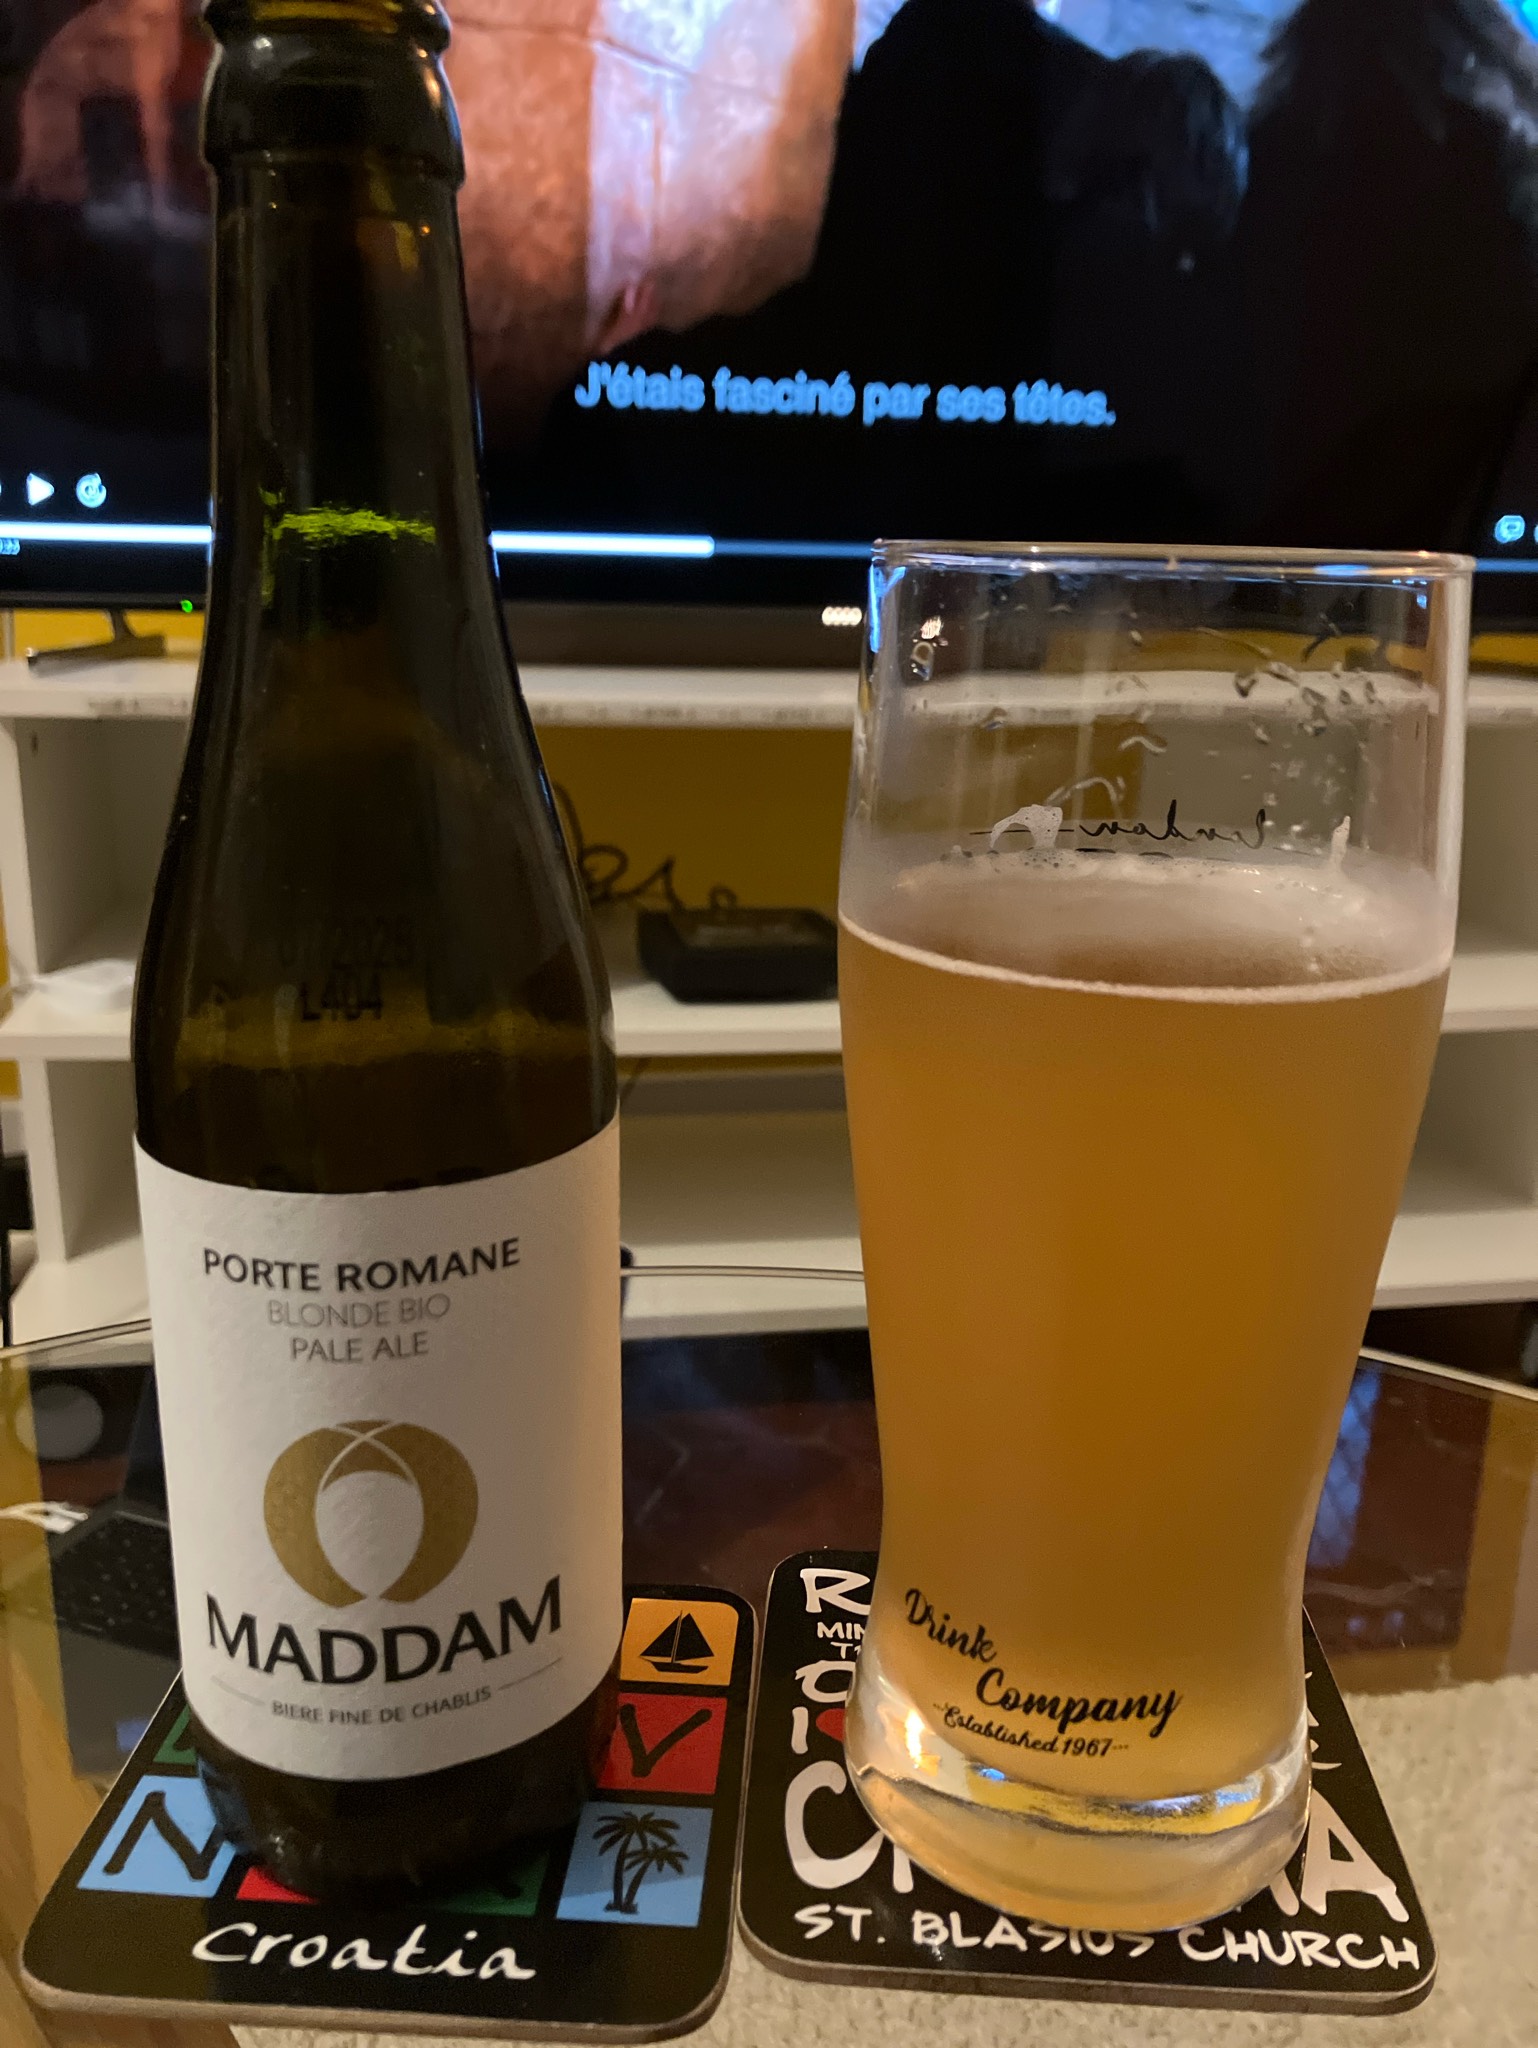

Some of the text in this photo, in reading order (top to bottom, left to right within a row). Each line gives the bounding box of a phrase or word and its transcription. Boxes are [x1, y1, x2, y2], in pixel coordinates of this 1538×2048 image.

[575, 360, 705, 411] J'étais
[712, 366, 856, 418] fasciné
[863, 381, 931, 427] par
[936, 384, 1007, 423] ses
[203, 1237, 520, 1291] PORTE ROMANE
[267, 1293, 451, 1328] BLONDE BIO
[290, 1331, 429, 1363] PALE ALE
[206, 1574, 563, 1685] MADDAM
[905, 1588, 997, 1663] Drink
[329, 1707, 373, 1725] FINE
[379, 1704, 402, 1723] DE
[411, 1686, 492, 1718] CHABLIS
[943, 1705, 1113, 1757] Established 1967
[976, 1667, 1184, 1738] Company
[192, 1922, 537, 1980] Croatia
[794, 1903, 1420, 1971] ST. BLASIUS CHURCH
